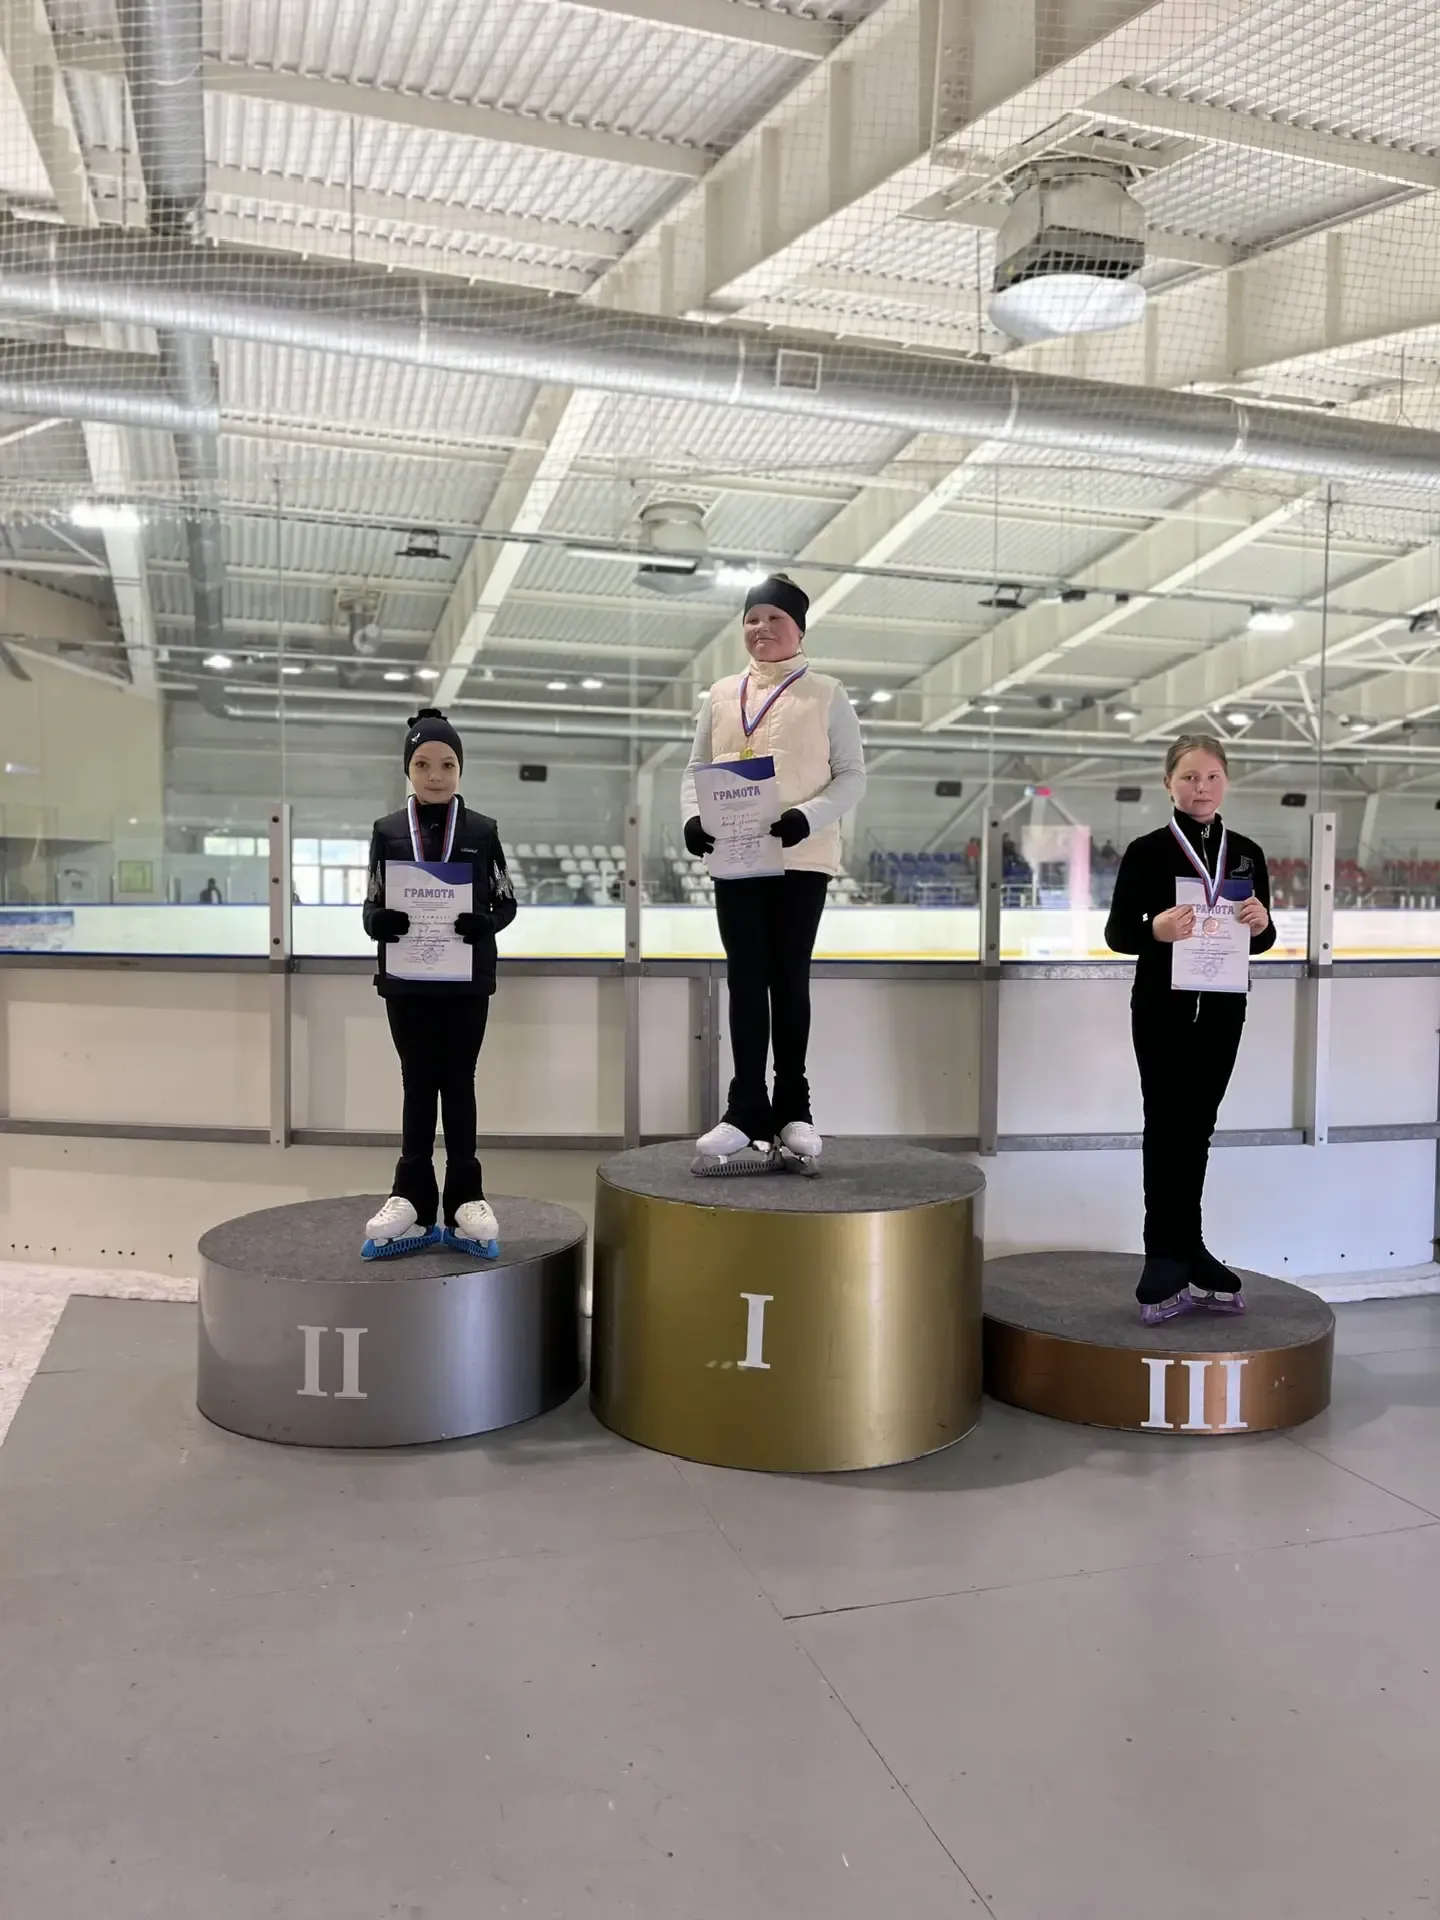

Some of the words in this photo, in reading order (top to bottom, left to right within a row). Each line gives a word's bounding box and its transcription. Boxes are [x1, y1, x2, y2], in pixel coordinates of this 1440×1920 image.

[713, 785, 761, 801] ГРАМОТА
[404, 888, 455, 899] ГРАМОТА
[296, 1325, 368, 1398] II
[737, 1292, 774, 1369] I
[1140, 1357, 1249, 1430] III
